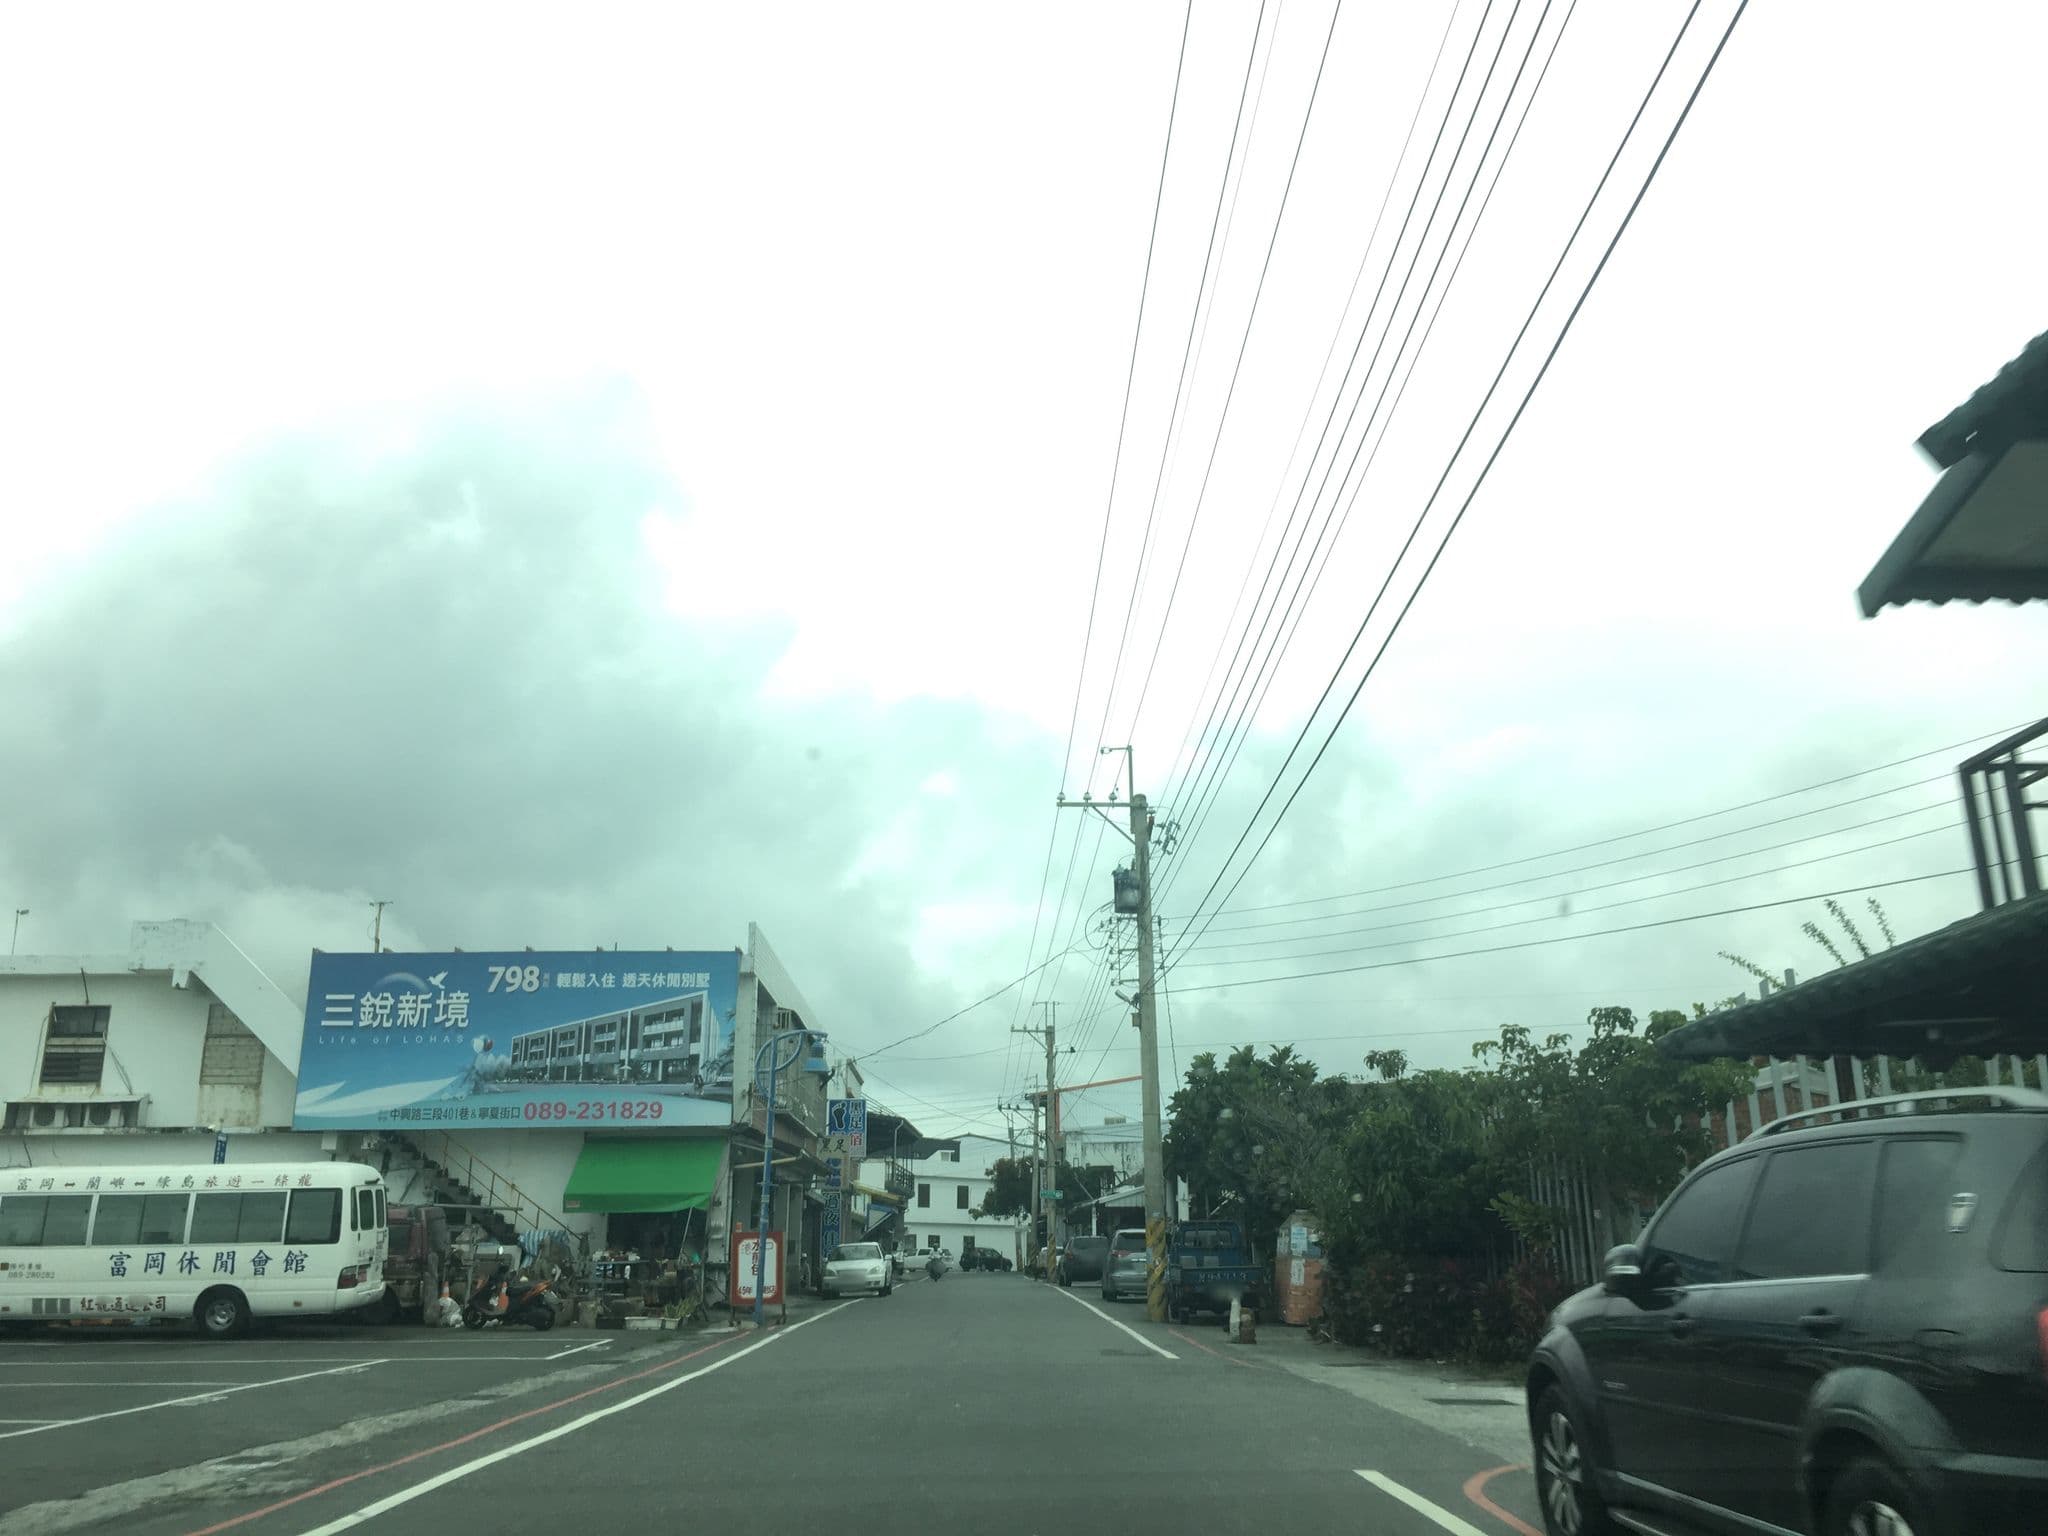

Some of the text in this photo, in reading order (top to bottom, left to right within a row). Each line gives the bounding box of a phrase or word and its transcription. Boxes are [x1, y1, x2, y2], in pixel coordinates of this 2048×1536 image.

[488, 965, 540, 993] 798
[556, 972, 615, 989] 輕鬆入住
[622, 972, 711, 988] 透天休閒別墅
[320, 988, 470, 1028] 三銳新境
[319, 1034, 465, 1044] Life of LOHAS
[524, 1101, 663, 1121] 089-231829
[109, 1250, 309, 1278] 富岡休閒會館
